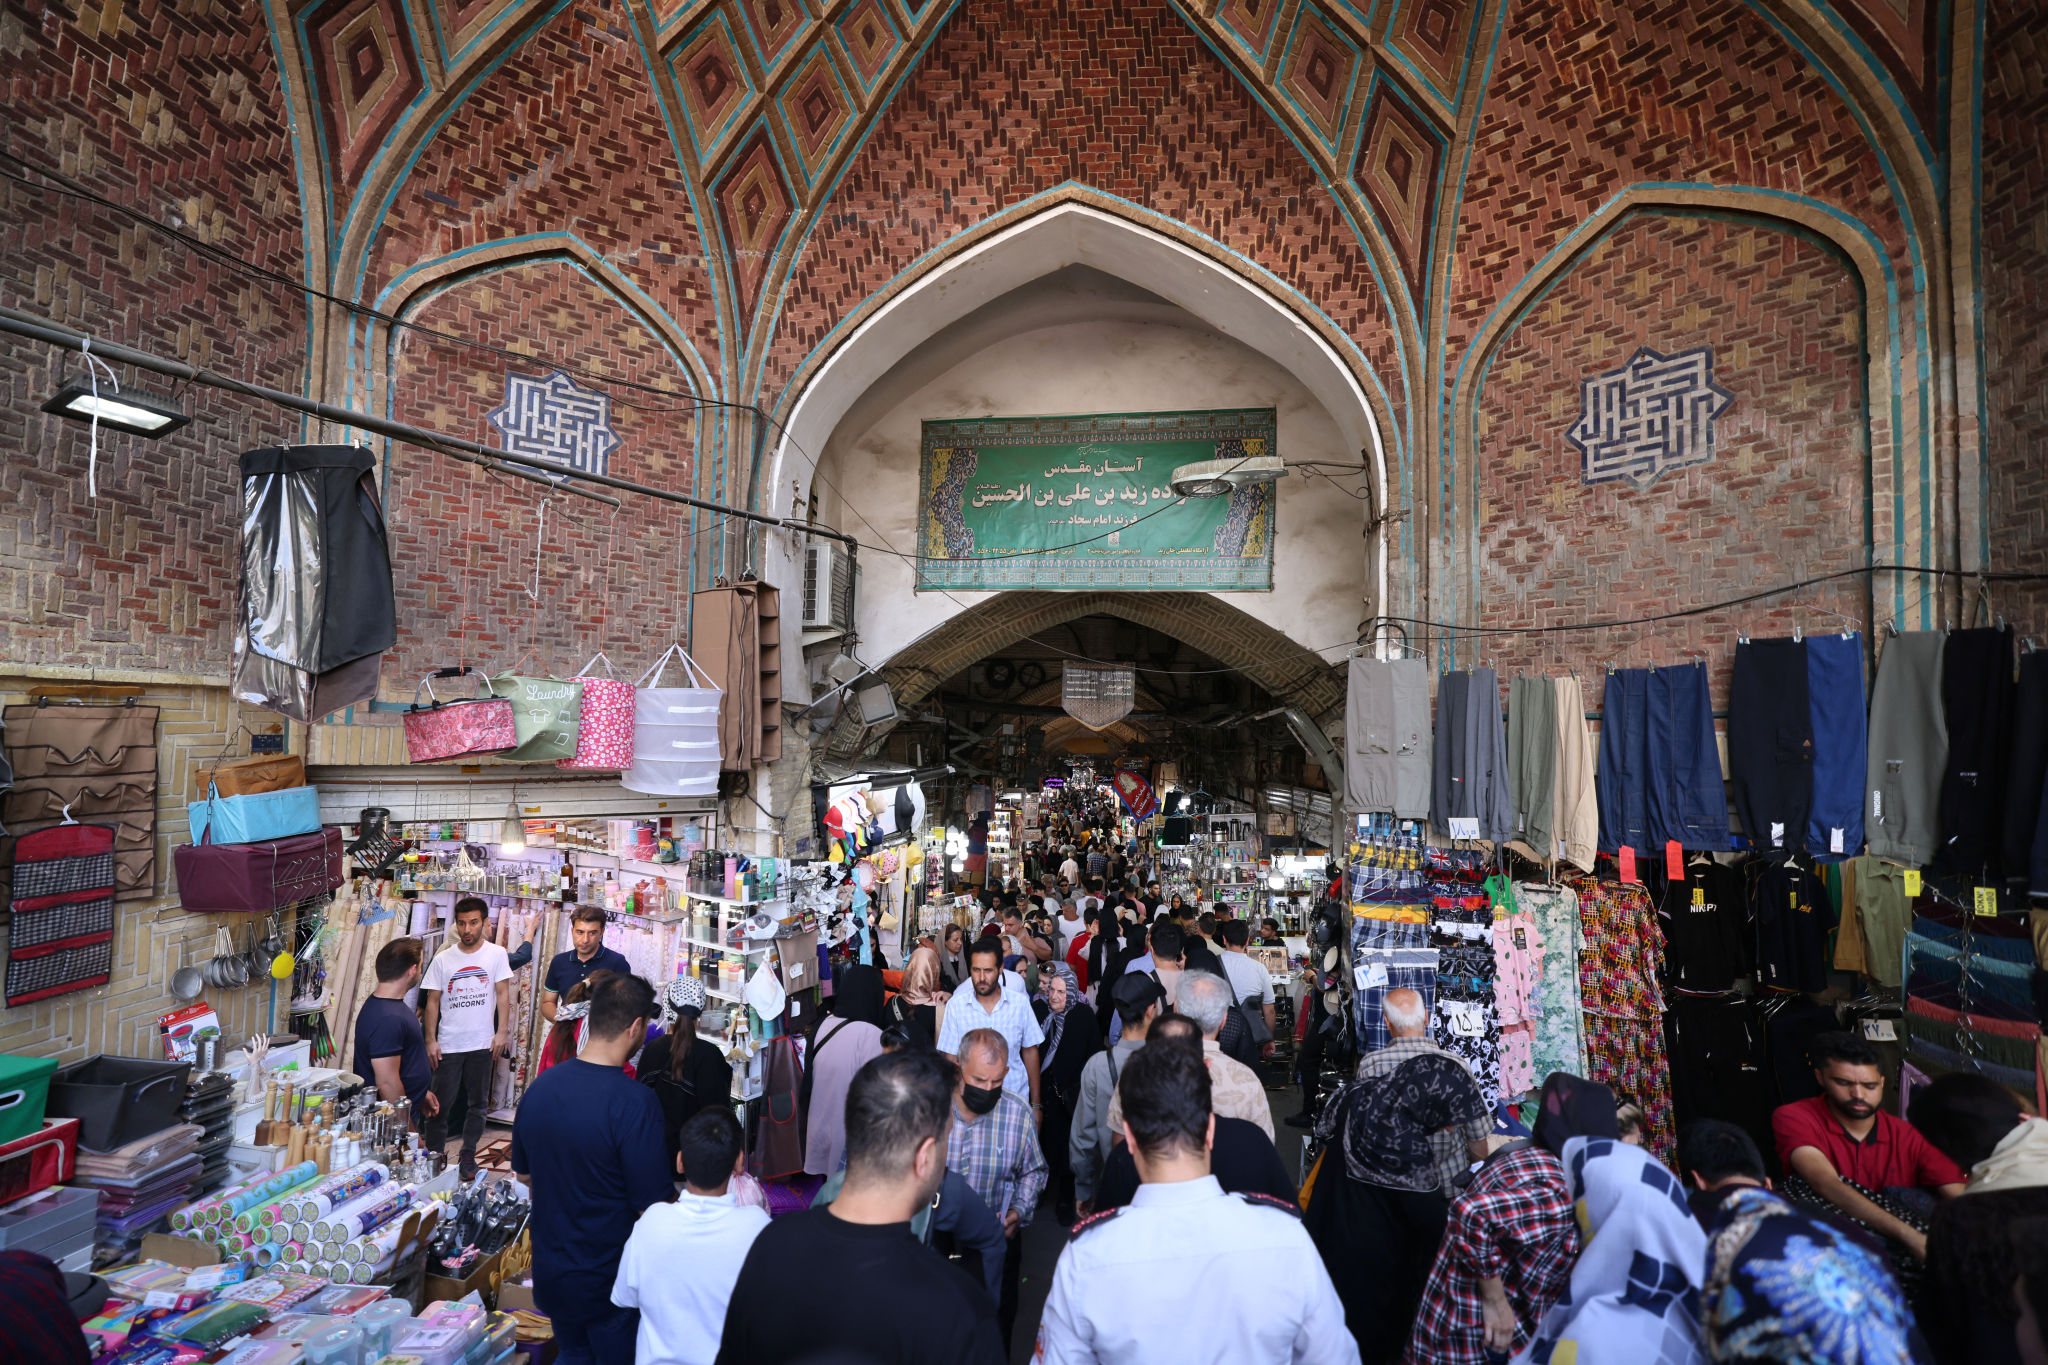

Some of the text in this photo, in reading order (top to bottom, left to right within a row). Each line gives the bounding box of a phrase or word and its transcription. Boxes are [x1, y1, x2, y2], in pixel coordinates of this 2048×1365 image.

[1044, 456, 1144, 478] آستان مقدس
[972, 482, 1031, 508] الحسین
[1034, 488, 1054, 507] بن
[1057, 482, 1091, 506] علی
[1094, 487, 1115, 506] بن
[1119, 485, 1148, 506] زید
[1068, 513, 1138, 528] فرزند امام سجاد
[526, 684, 576, 701] Laundry
